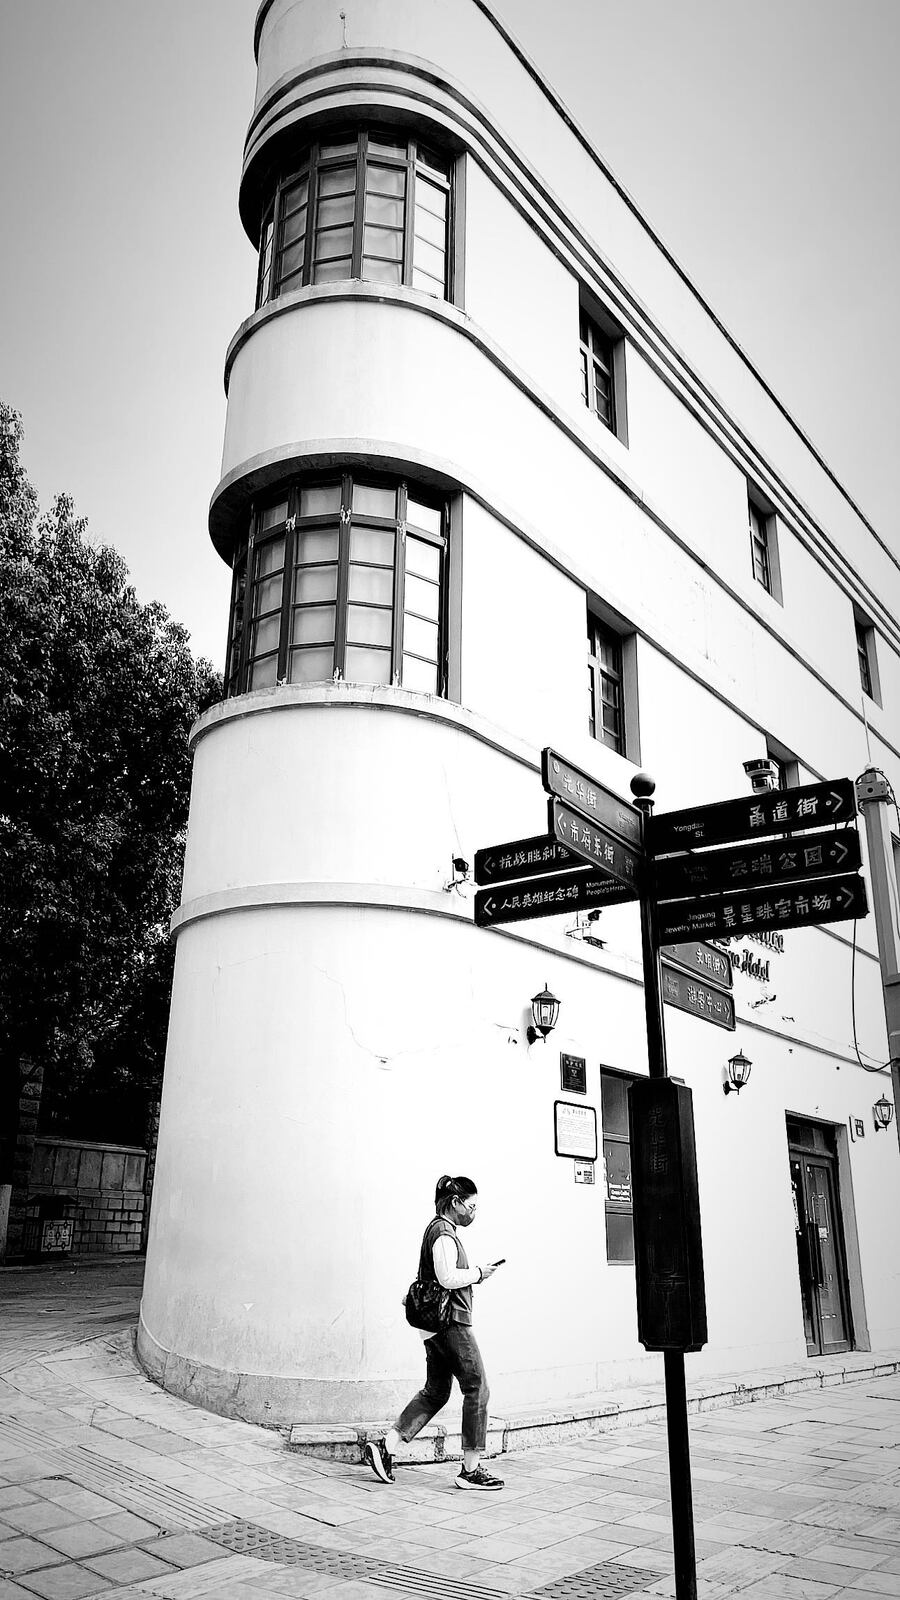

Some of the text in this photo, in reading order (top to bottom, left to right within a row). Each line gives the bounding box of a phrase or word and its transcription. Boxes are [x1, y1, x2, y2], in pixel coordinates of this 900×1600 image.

[562, 774, 598, 810] 光华街
[749, 796, 819, 828] 甬道街
[570, 821, 615, 865] 市府东街
[729, 845, 823, 878] 云瑞公园
[500, 884, 580, 910] 人民英雄纪念碑
[723, 893, 832, 928] 景星珠宝市场
[692, 920, 717, 930] Market
[696, 947, 721, 975] 文明街
[687, 985, 722, 1013] 游客中心
